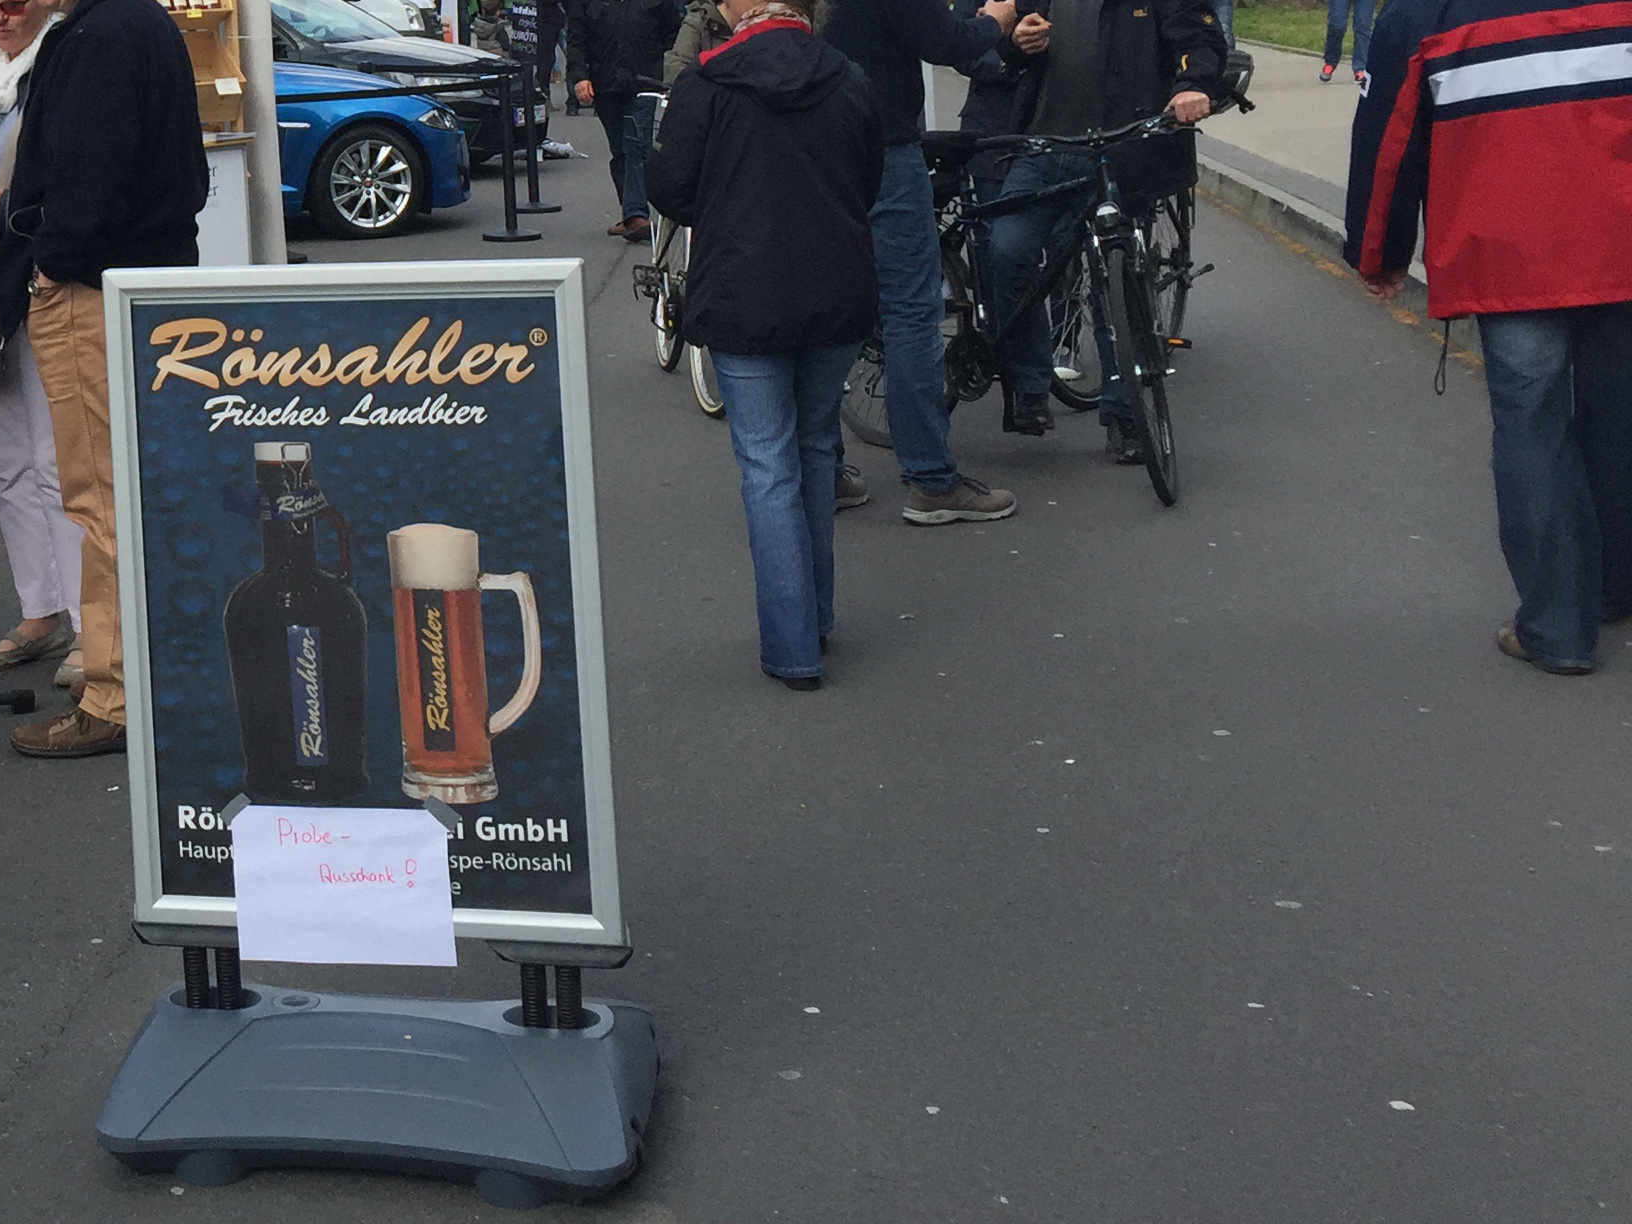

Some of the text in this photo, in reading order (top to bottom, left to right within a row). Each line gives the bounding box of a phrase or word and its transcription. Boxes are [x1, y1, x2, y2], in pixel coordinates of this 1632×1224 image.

[203, 392, 489, 432] Frisches Landbier
[421, 603, 452, 733] Rönsahler
[475, 816, 568, 843] GmbH
[449, 852, 572, 873] spe-Rönsahl
